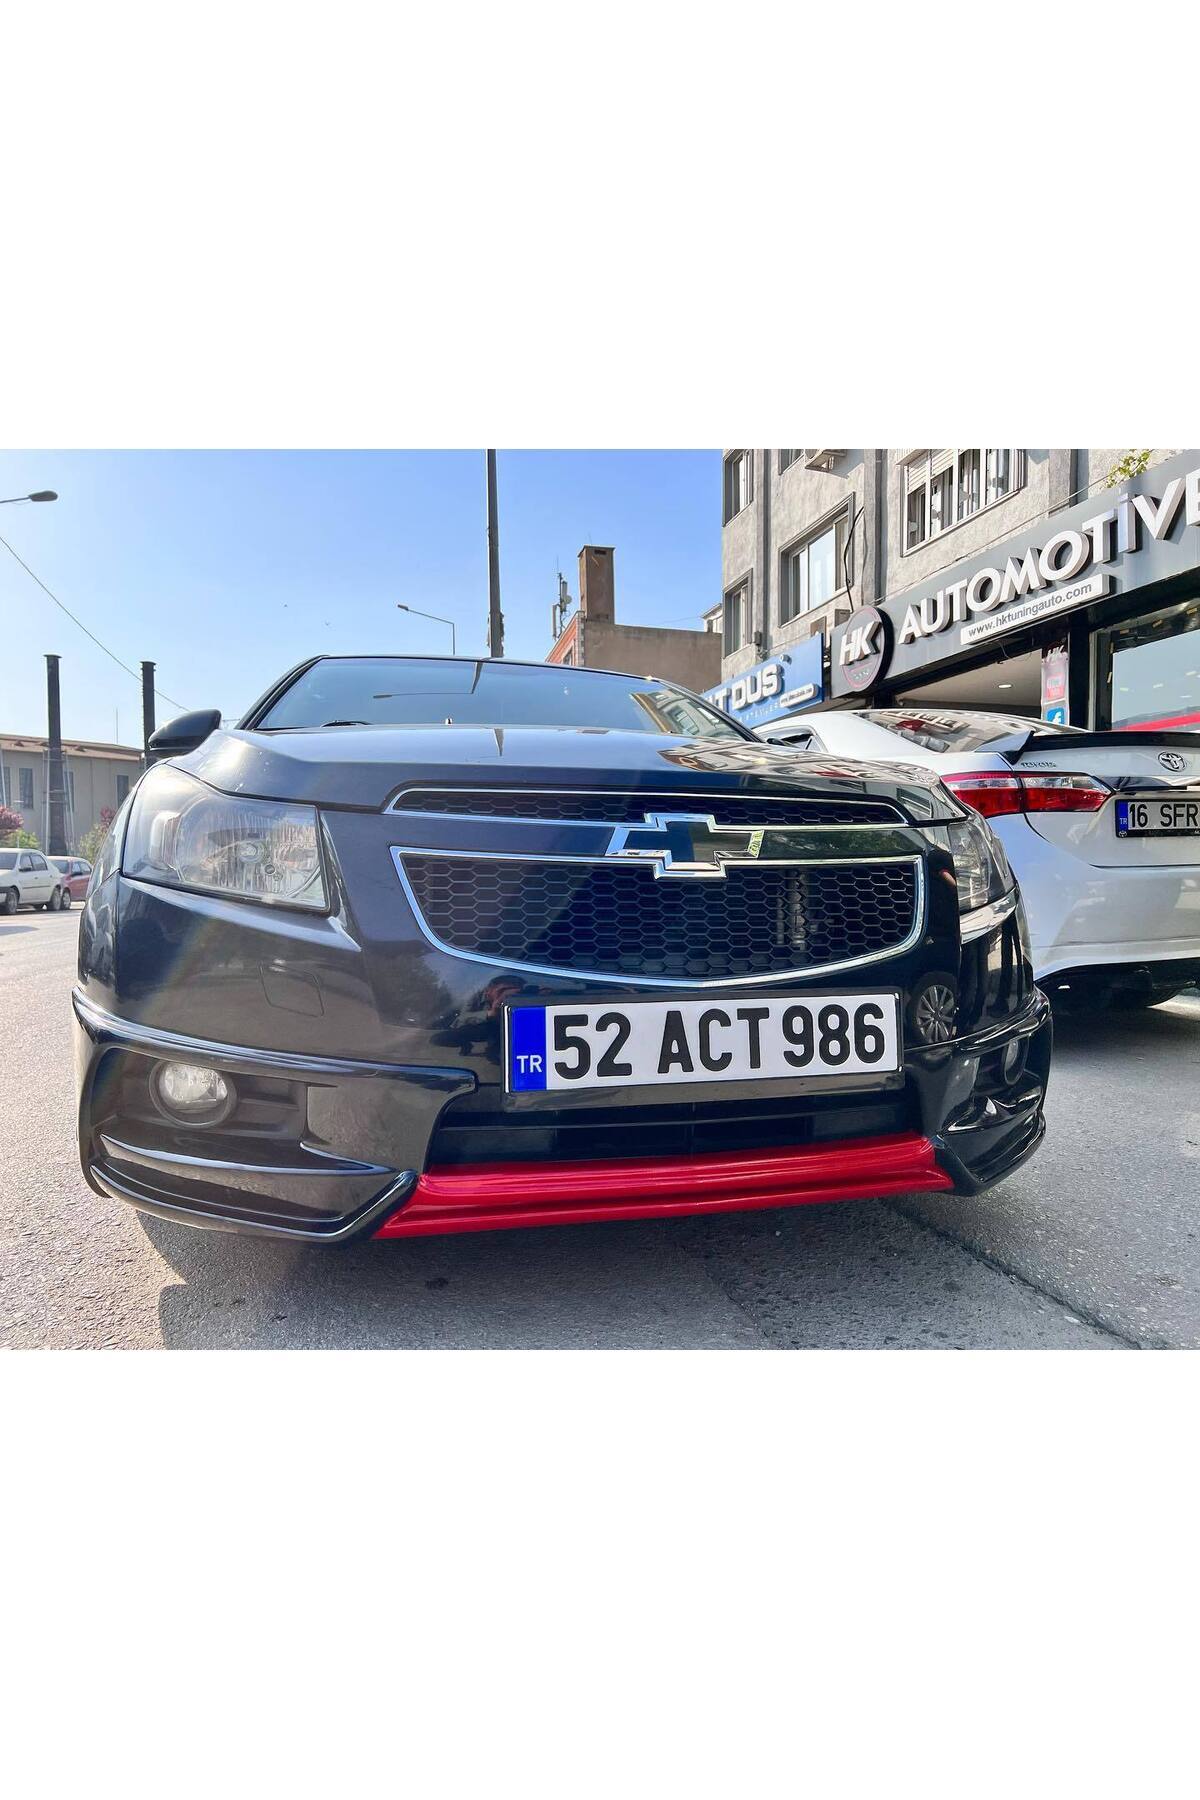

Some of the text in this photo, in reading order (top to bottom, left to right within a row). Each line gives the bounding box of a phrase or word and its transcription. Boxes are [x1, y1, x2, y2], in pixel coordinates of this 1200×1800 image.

[968, 583, 1092, 637] www.hktuningauto.com
[839, 621, 879, 666] HK
[1129, 803, 1148, 828] 16
[1160, 803, 1199, 828] SFR
[516, 1002, 885, 1080] TR 52 ACT 986
